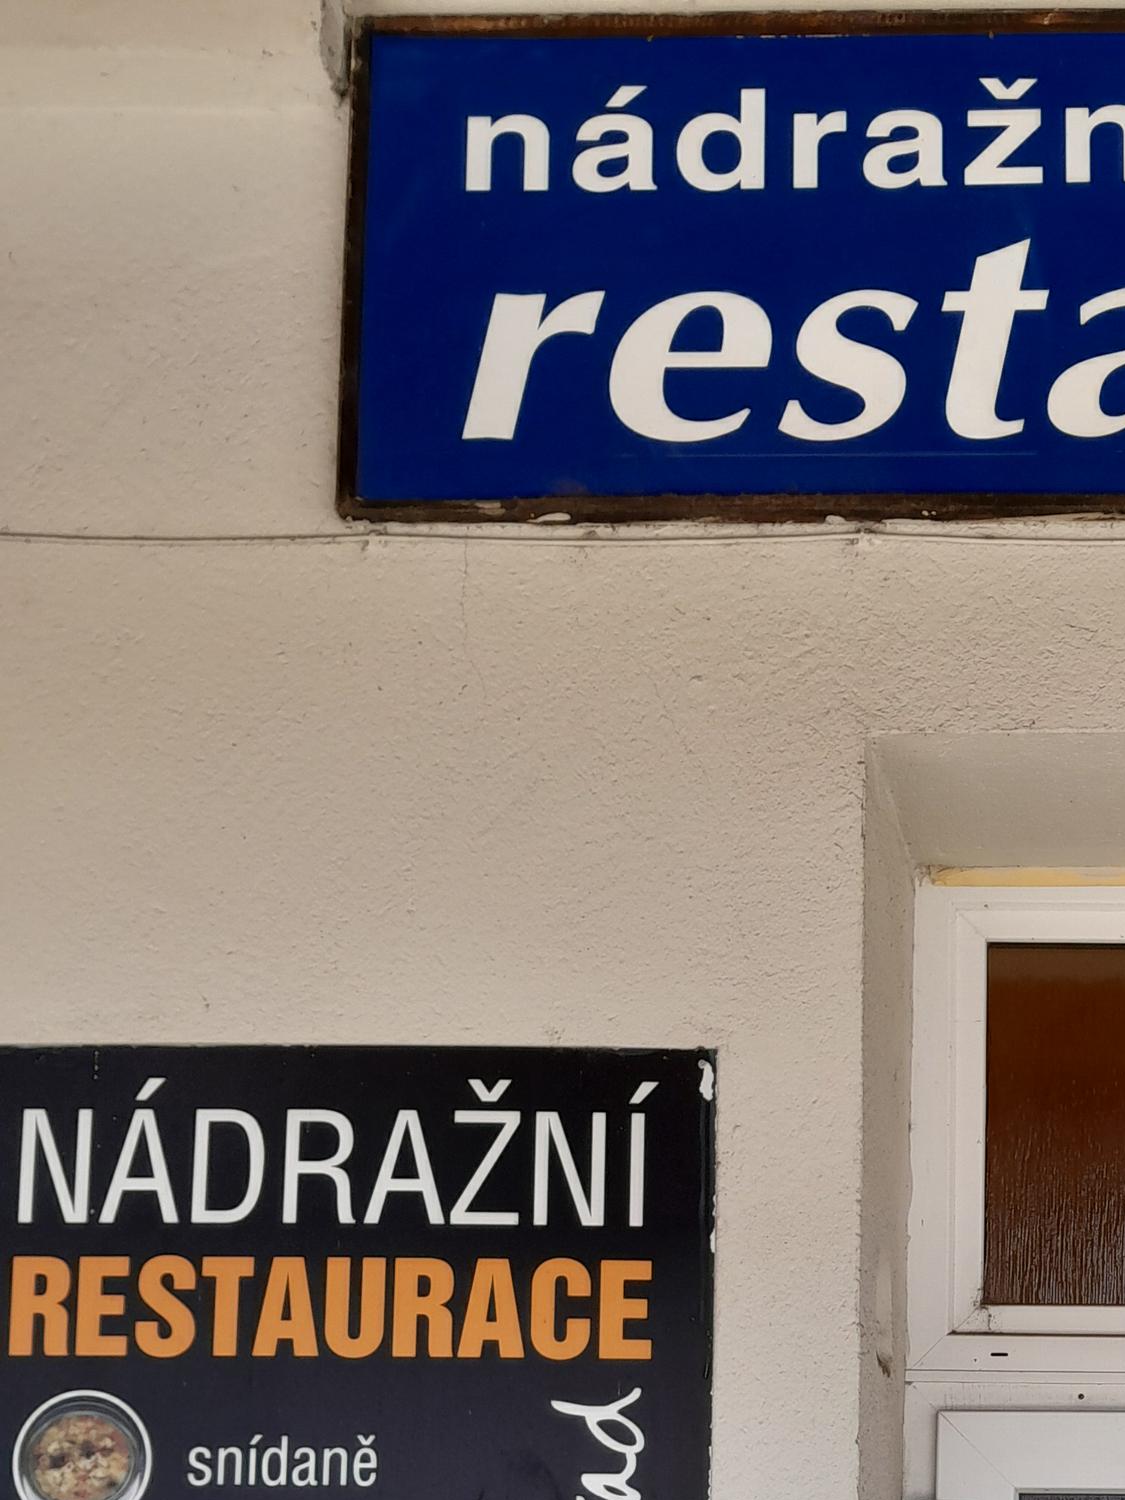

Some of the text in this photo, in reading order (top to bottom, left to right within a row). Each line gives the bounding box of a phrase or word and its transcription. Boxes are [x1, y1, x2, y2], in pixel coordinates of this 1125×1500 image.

[16, 1077, 659, 1227] NÁDRAŽNÍ
[7, 1254, 654, 1361] RESTAURACE
[186, 1434, 379, 1489] snídaně
